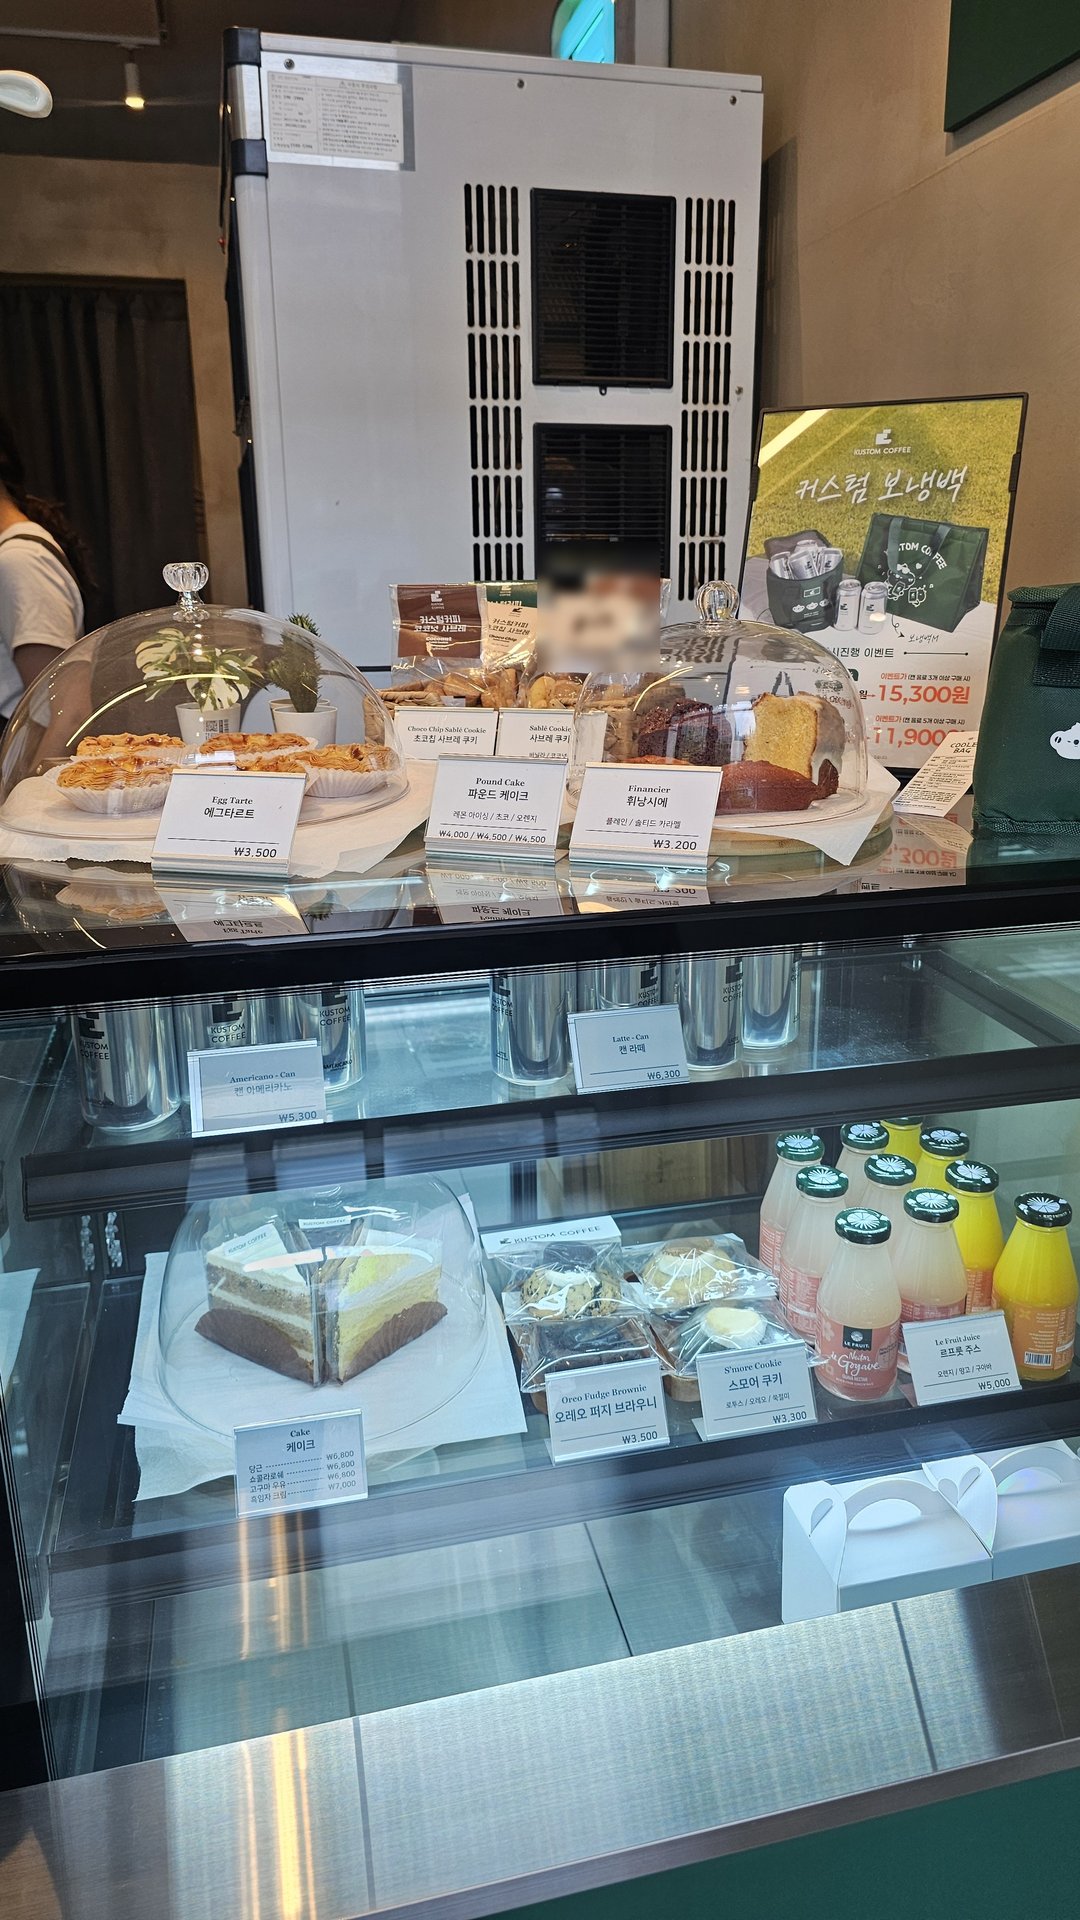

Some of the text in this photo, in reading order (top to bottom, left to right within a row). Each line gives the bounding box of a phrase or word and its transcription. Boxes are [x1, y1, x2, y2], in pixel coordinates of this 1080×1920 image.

[854, 446, 911, 456] KUSTOM COFFEE
[795, 464, 968, 504] 커스텀 보냉백
[832, 647, 894, 658] 시진행 이벤트
[879, 685, 970, 705] 15,300원
[428, 726, 444, 734] Chip
[444, 726, 463, 734] Sablé
[413, 735, 478, 744] 초코칩 사브레 쿠키
[529, 734, 571, 744] 사브레 쿠키
[873, 727, 958, 748] 11,900
[476, 777, 525, 787] Pound Cake
[468, 788, 529, 801] 파운드 케이크
[628, 785, 671, 794] Financier
[212, 796, 253, 805] Egg Tarte
[626, 795, 668, 808] 휘낭시에
[203, 807, 255, 819] 에그타르트
[453, 810, 467, 819] 레몬
[468, 811, 489, 821] 아이싱
[496, 812, 510, 821] 초코
[516, 814, 538, 824] 오렌지
[605, 817, 628, 827] 플레인
[634, 819, 657, 827] 솔티드
[658, 819, 681, 829] 카라멜
[320, 1006, 351, 1017] KUSTOM
[320, 1014, 351, 1026] COFFEE
[211, 1023, 246, 1034] KUSTOM
[211, 1032, 246, 1043] COFFEE
[619, 1043, 646, 1054] 캔 라떼
[229, 1074, 274, 1084] Americano
[234, 1082, 293, 1097] 캔 아메리카노
[247, 1232, 267, 1245] COFFEE
[513, 1225, 600, 1244] KUSTOM COFFEE
[944, 1336, 962, 1345] Fruit
[963, 1333, 981, 1341] Juice
[940, 1343, 981, 1358] 르프룻 주스
[724, 1359, 782, 1375] S'more Cookie
[938, 1368, 955, 1378] 오렌지
[958, 1366, 971, 1375] 망고
[728, 1372, 783, 1391] 스모어 쿠키
[561, 1384, 647, 1404] Oreo Fudge Brownie
[749, 1395, 767, 1405] 오레오
[554, 1396, 657, 1424] 오레오 퍼지 브라우니
[290, 1428, 311, 1438] Cake
[286, 1439, 315, 1453] 케이크
[249, 1464, 263, 1474] 당근
[249, 1470, 284, 1483] 쇼콜라로쉐
[250, 1483, 270, 1493] 고구마
[272, 1481, 287, 1489] 우유
[273, 1491, 287, 1500] 크림
